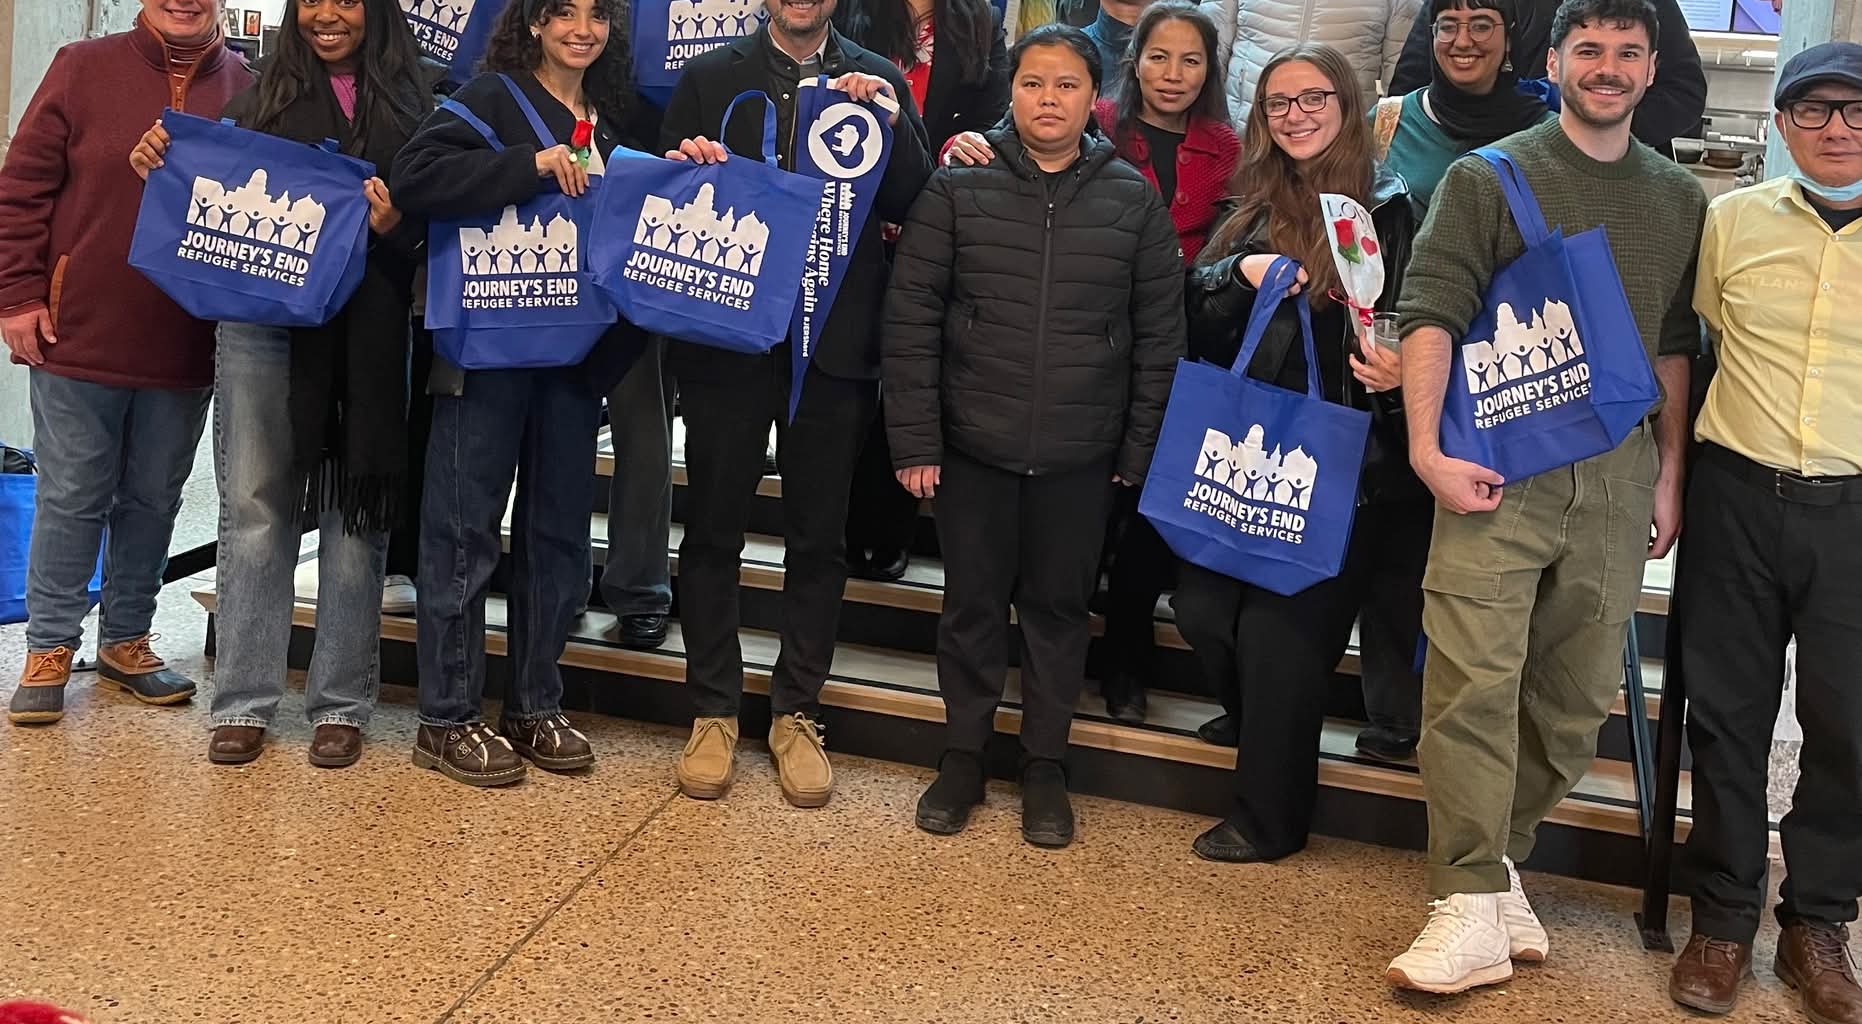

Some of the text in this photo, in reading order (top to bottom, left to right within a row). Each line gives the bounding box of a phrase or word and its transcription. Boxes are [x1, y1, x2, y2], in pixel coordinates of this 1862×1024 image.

[417, 38, 454, 61] RVICES
[433, 29, 459, 51] END
[666, 42, 730, 61] JOURN
[181, 230, 309, 275] JOURNEY'S END
[818, 180, 836, 287] Where Home
[177, 246, 306, 287] REFUGEE SERVICES
[463, 278, 578, 297] JOURNEY'S END
[623, 267, 751, 311] REFUGEE SERVICES
[627, 250, 755, 298] JOURNEY'S END
[801, 265, 819, 313] Again
[517, 296, 579, 307] SERVICES
[1473, 362, 1590, 418] JOURNEY'S END
[1475, 383, 1592, 430] REFUGEE SERVICE
[1183, 497, 1303, 545] REFUGEE SERVICES
[1188, 481, 1306, 532] JOURNEY'S END
